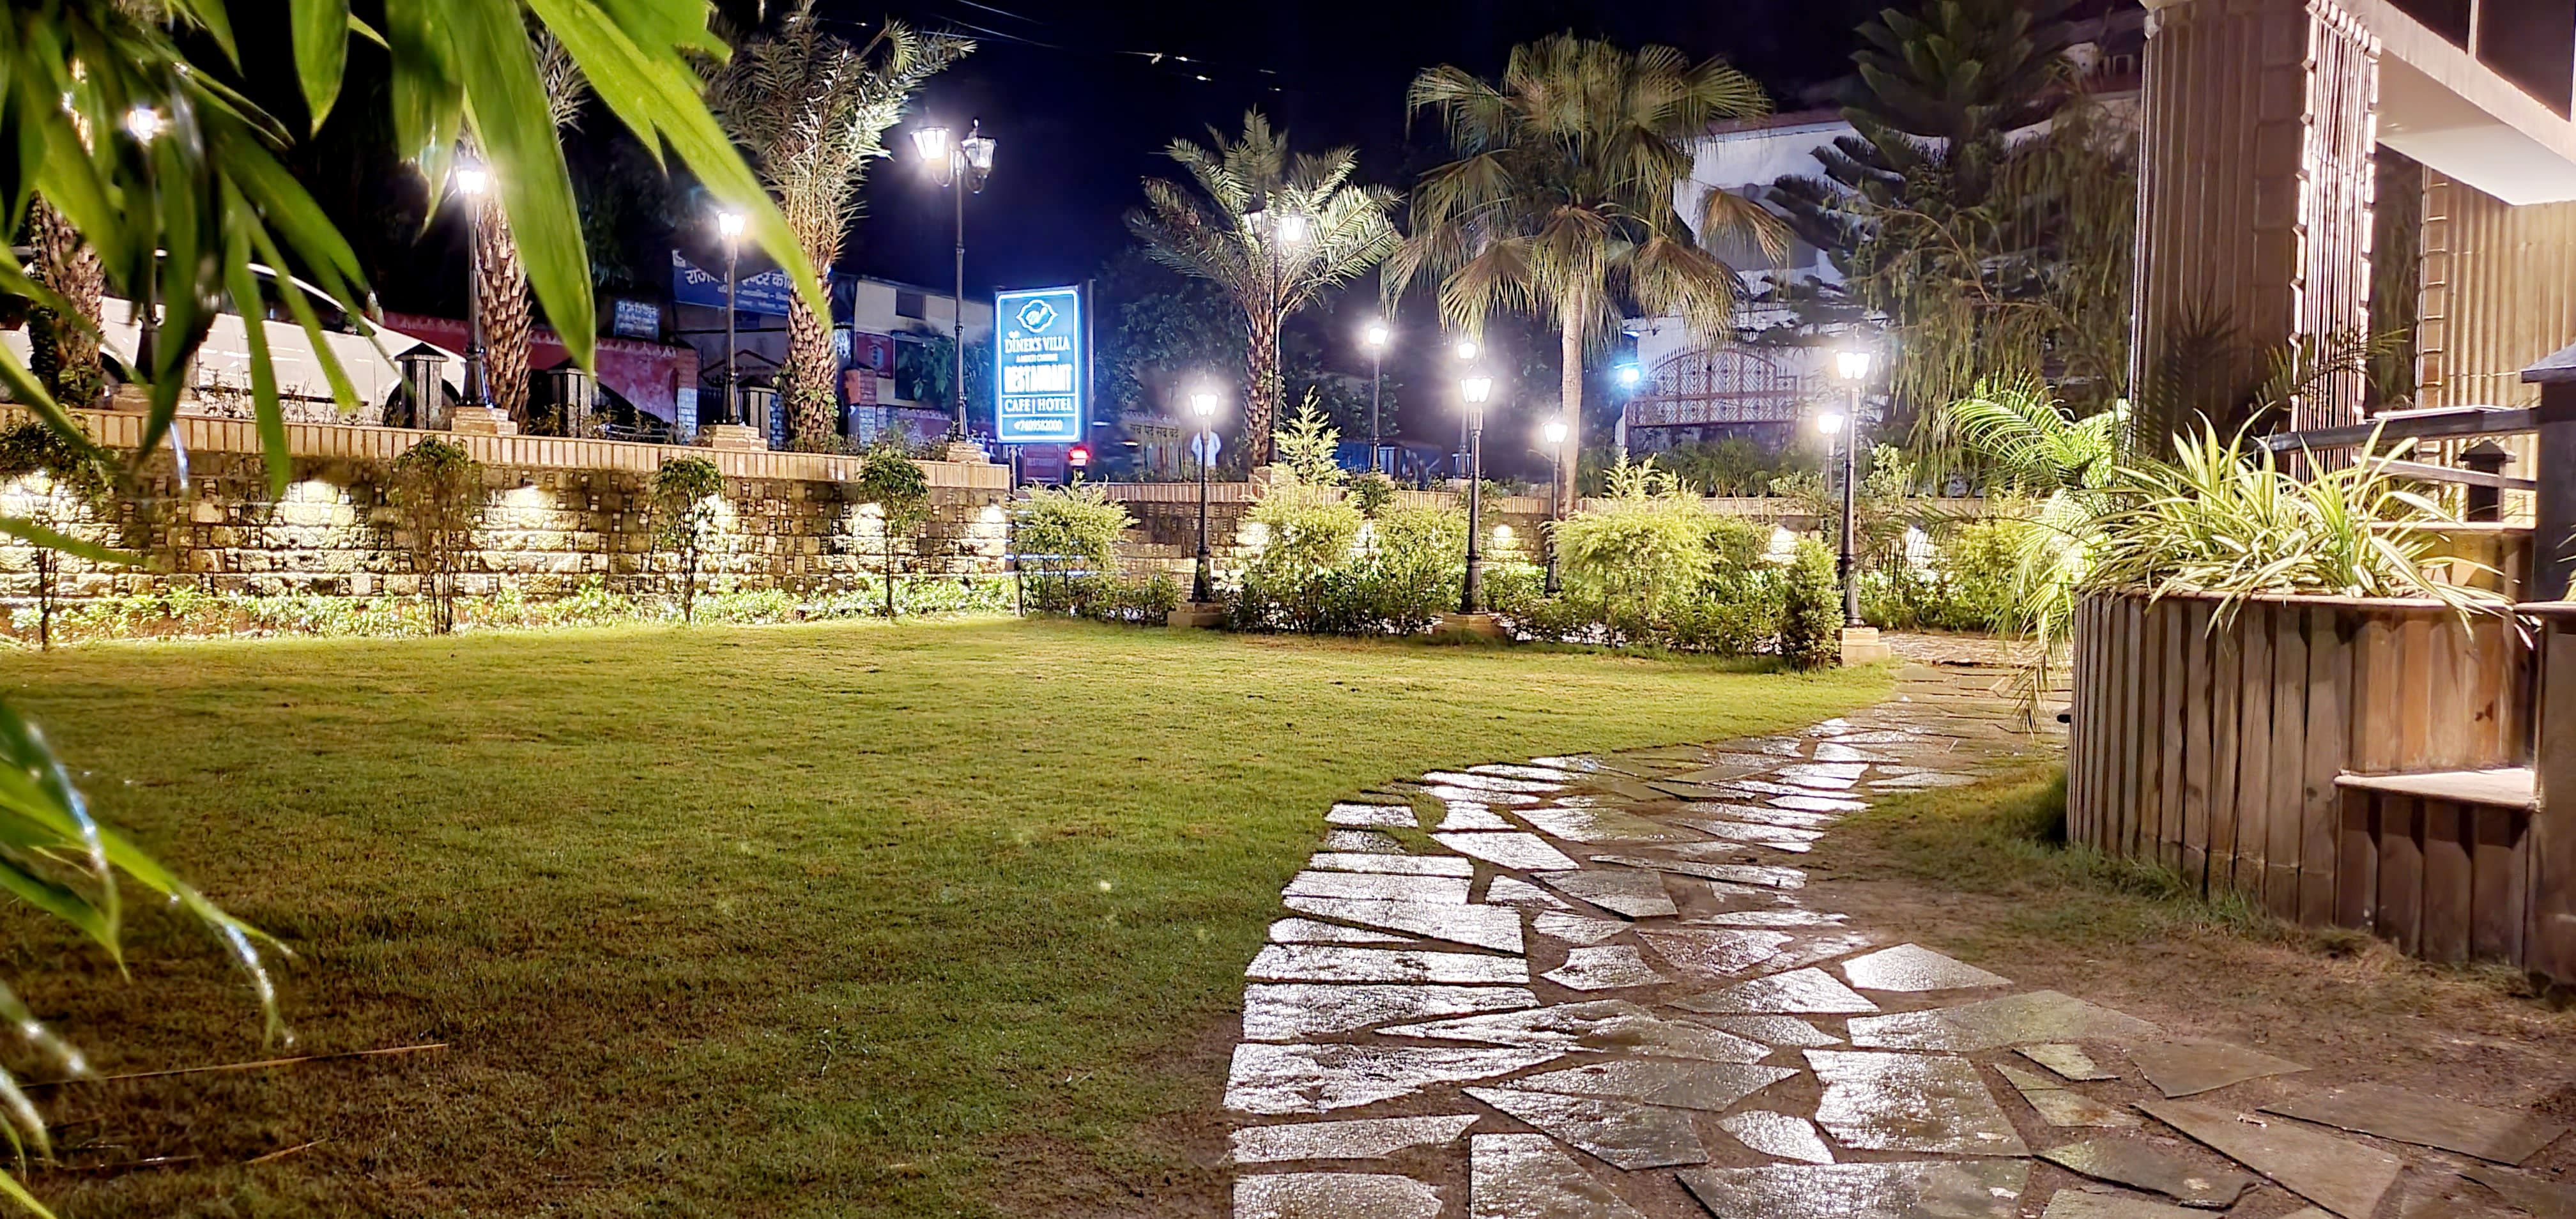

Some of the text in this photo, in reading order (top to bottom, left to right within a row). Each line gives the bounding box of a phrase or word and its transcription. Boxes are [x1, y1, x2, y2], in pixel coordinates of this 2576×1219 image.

[1004, 335, 1071, 353] DINER'S VILLA
[1004, 364, 1072, 393] RESTAURANT
[1005, 397, 1073, 412] CAFE HOTEL
